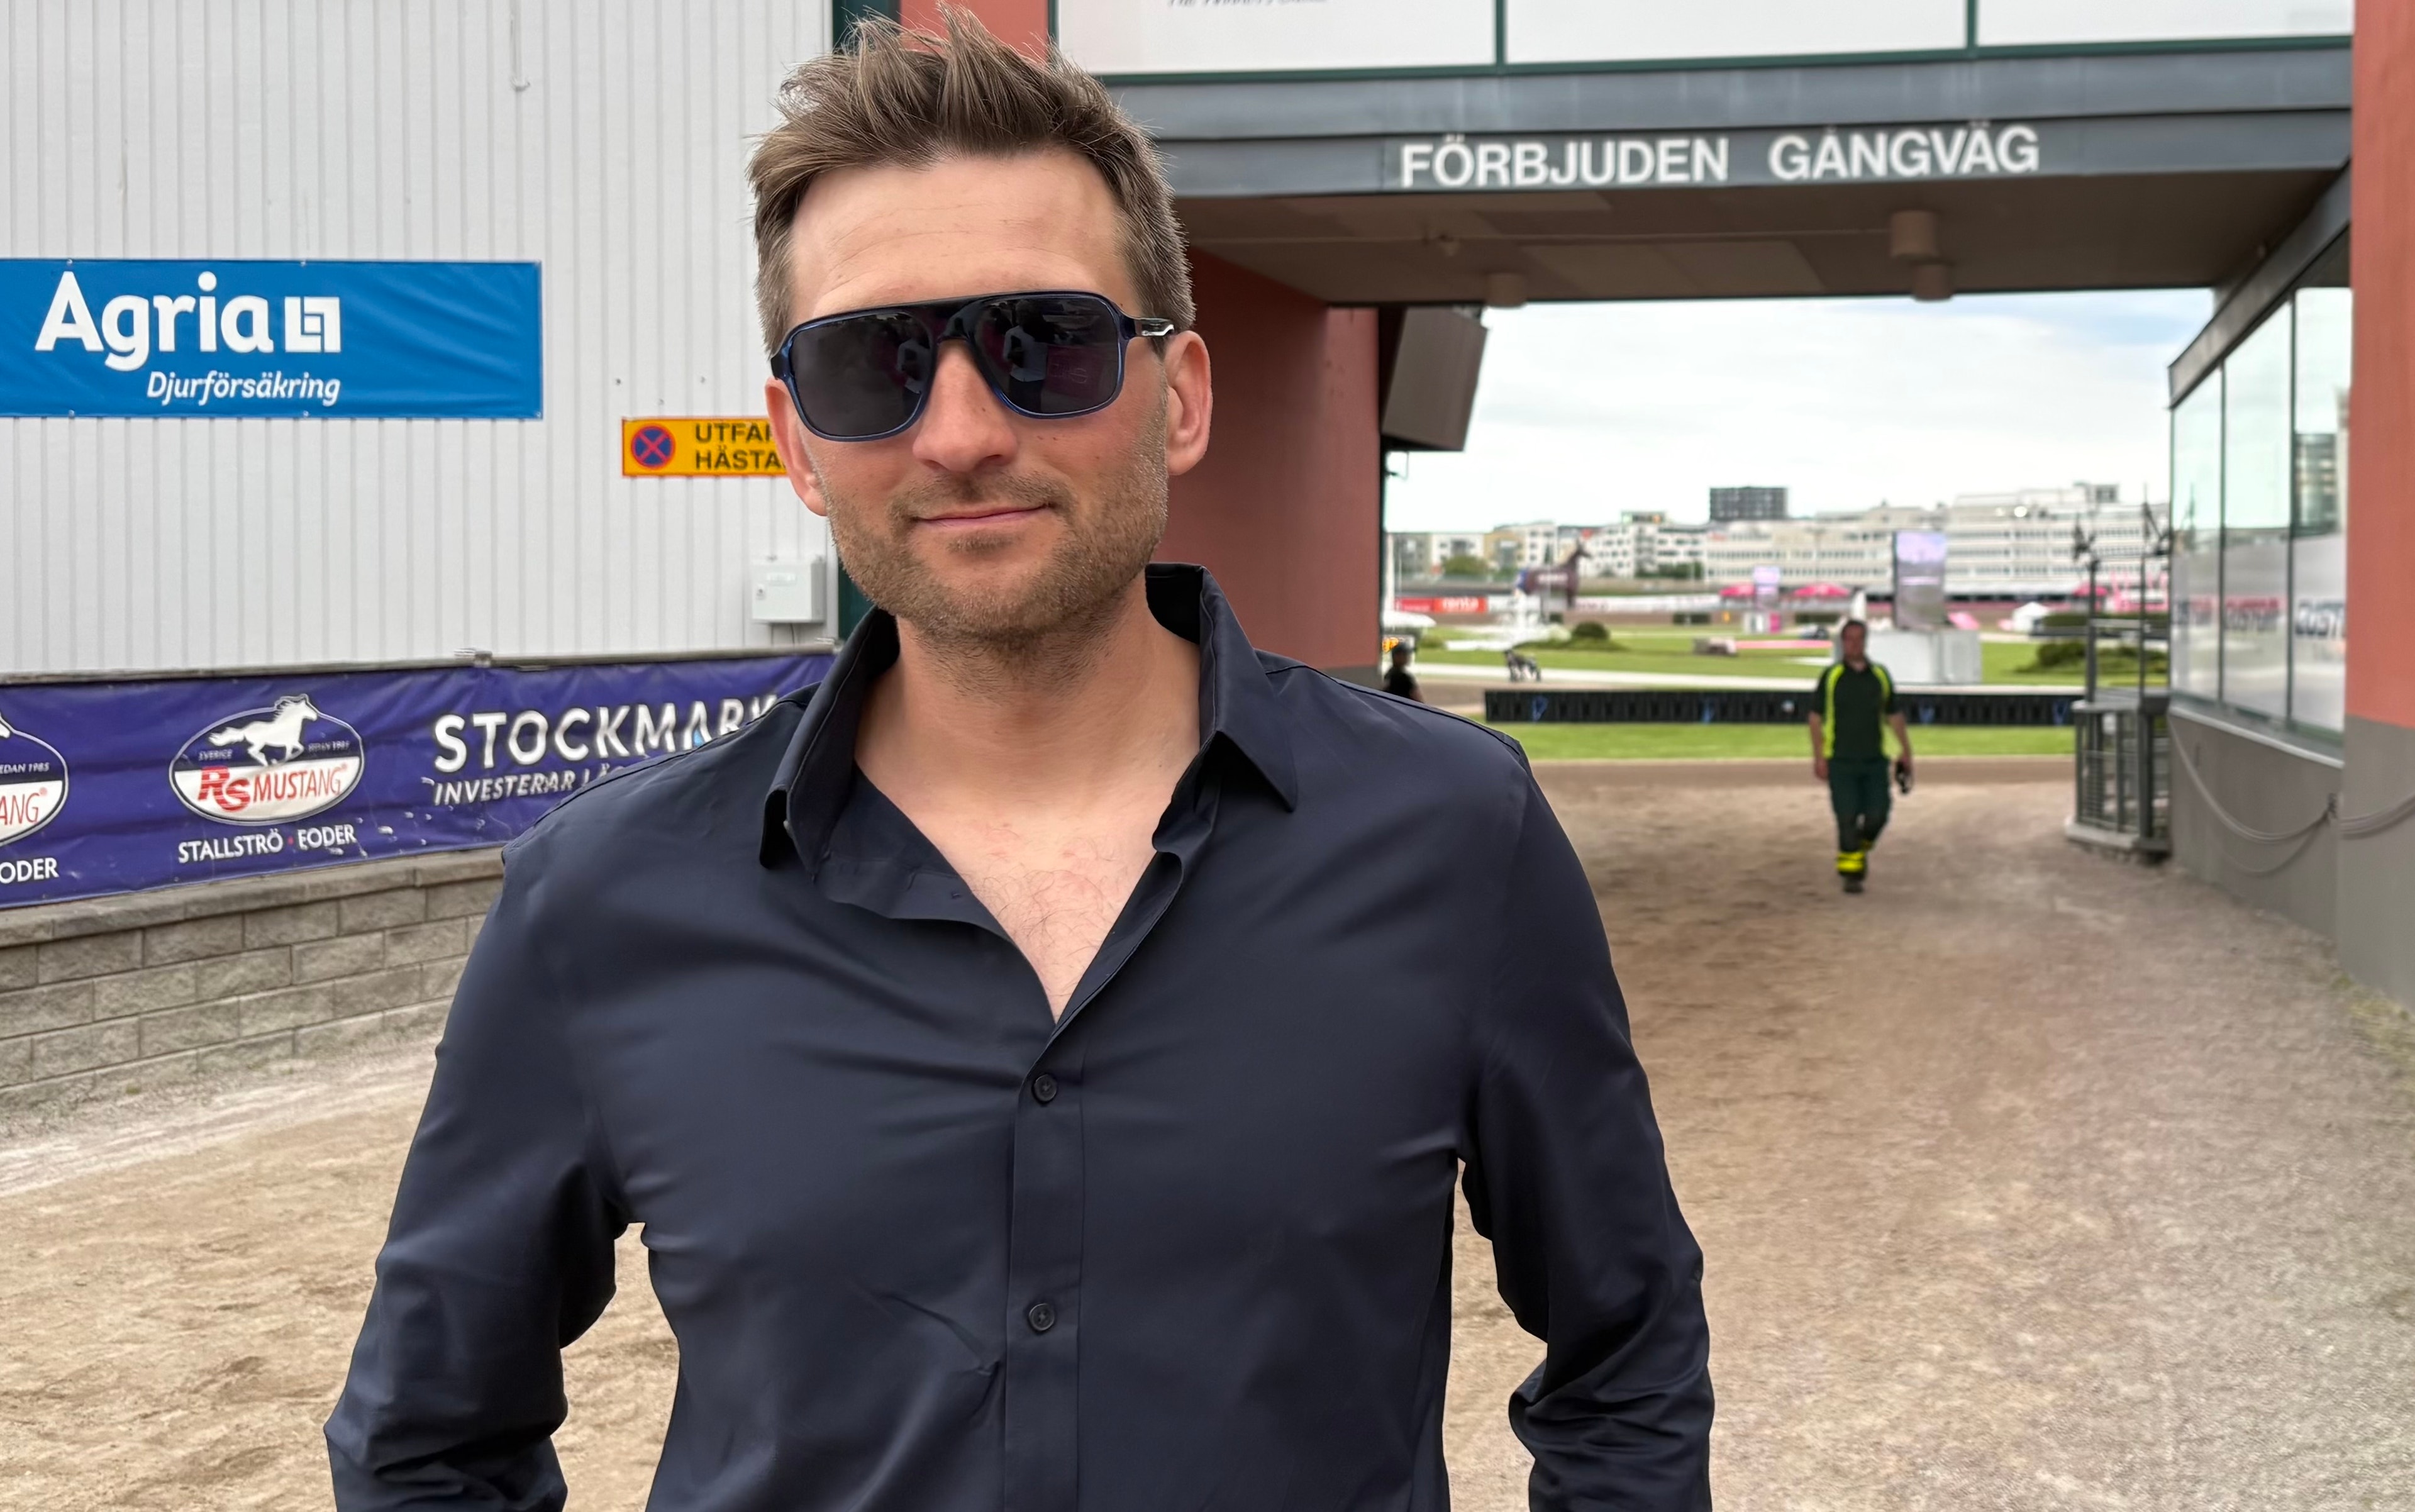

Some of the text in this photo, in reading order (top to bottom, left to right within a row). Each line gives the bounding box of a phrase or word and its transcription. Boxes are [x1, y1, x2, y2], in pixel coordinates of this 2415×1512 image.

[1401, 120, 2040, 187] FÖRBJUDEN GÅNGVÄG
[34, 270, 274, 372] Agria
[146, 370, 341, 406] Djurförsäkring
[695, 445, 786, 470] HÄSTA
[197, 765, 341, 812] RS MUSTANG
[435, 769, 576, 806] INVESTERAR
[178, 824, 357, 864] STALLSTRÖ FODER
